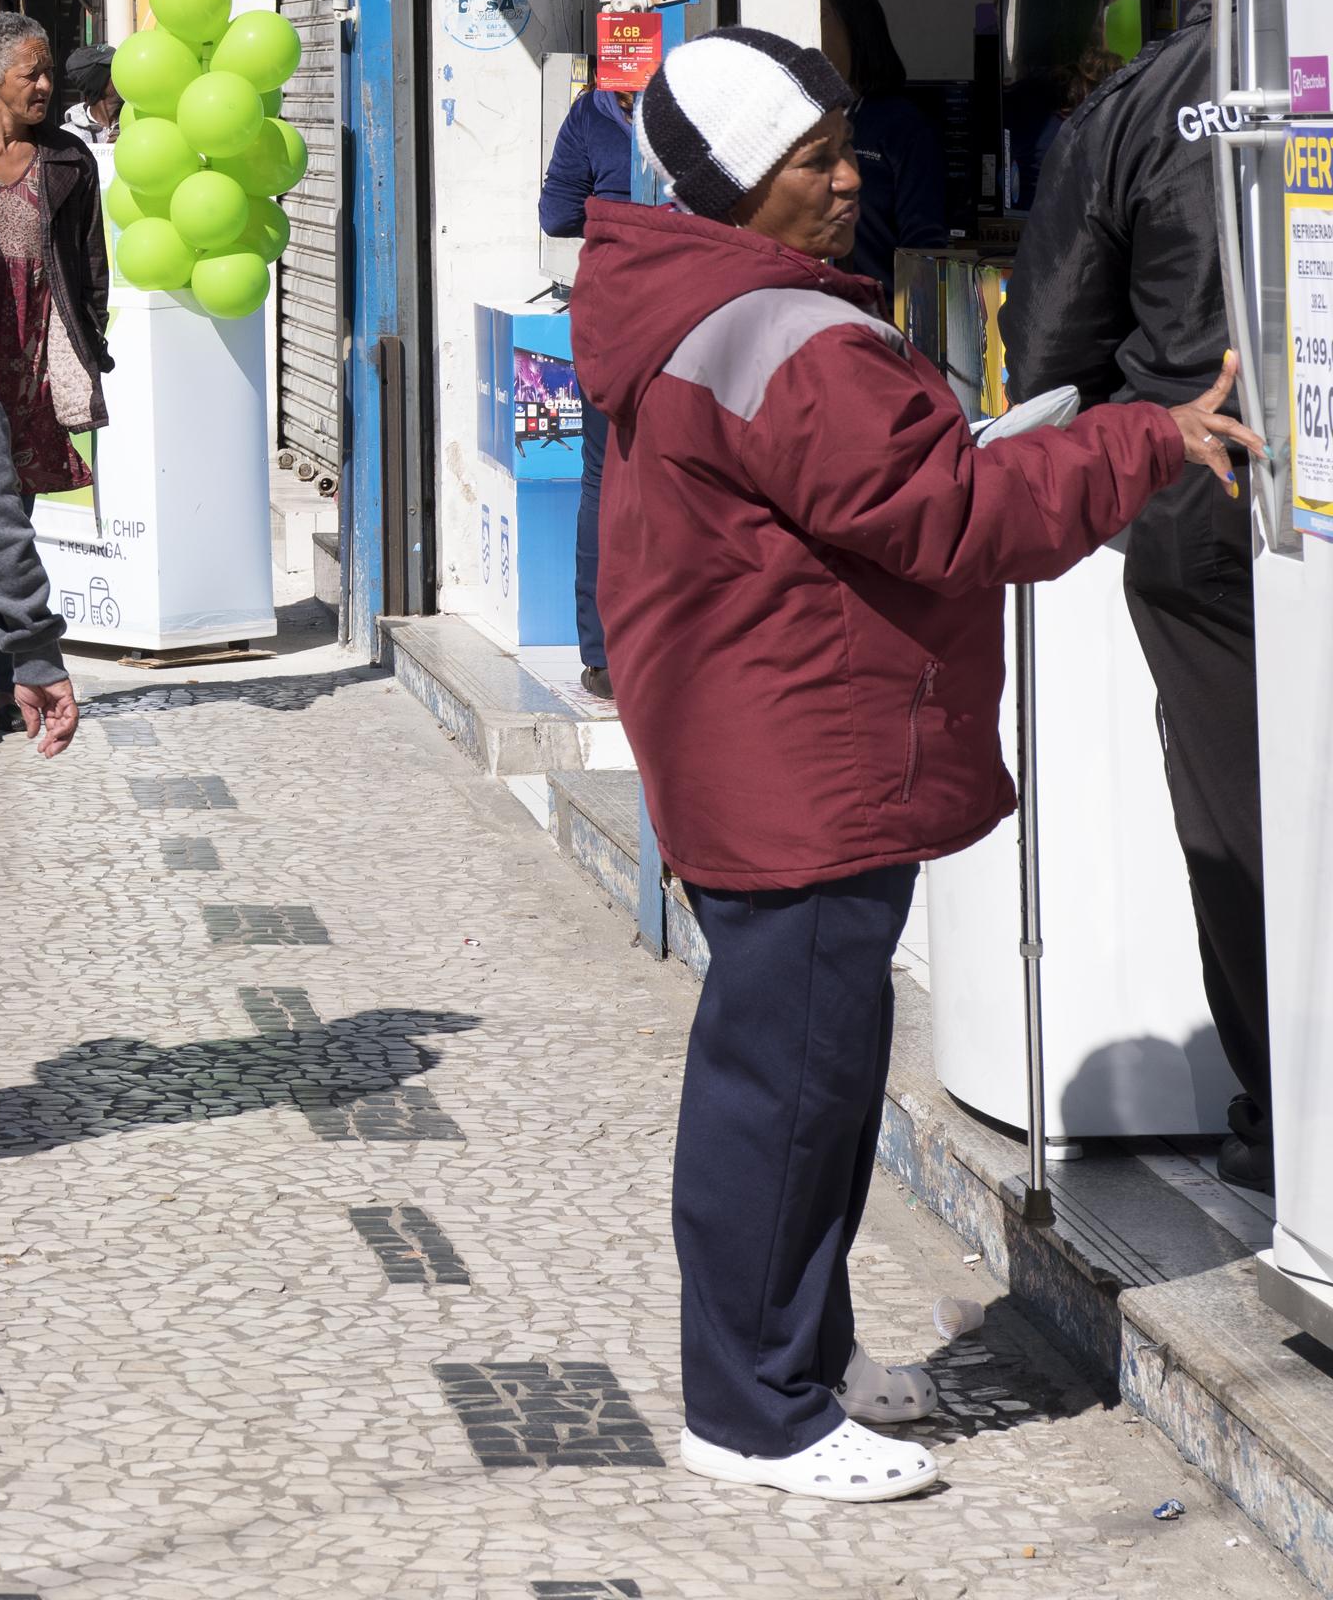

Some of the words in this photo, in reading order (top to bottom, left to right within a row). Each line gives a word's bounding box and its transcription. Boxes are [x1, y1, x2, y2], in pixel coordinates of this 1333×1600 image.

[614, 26, 621, 37] 4
[623, 26, 640, 37] GB
[1302, 74, 1326, 89] Electrolux
[1284, 136, 1333, 189] OFER
[1292, 223, 1333, 240] REFRIGERAD
[1295, 336, 1333, 372] 2.199,
[113, 520, 145, 538] CHIP
